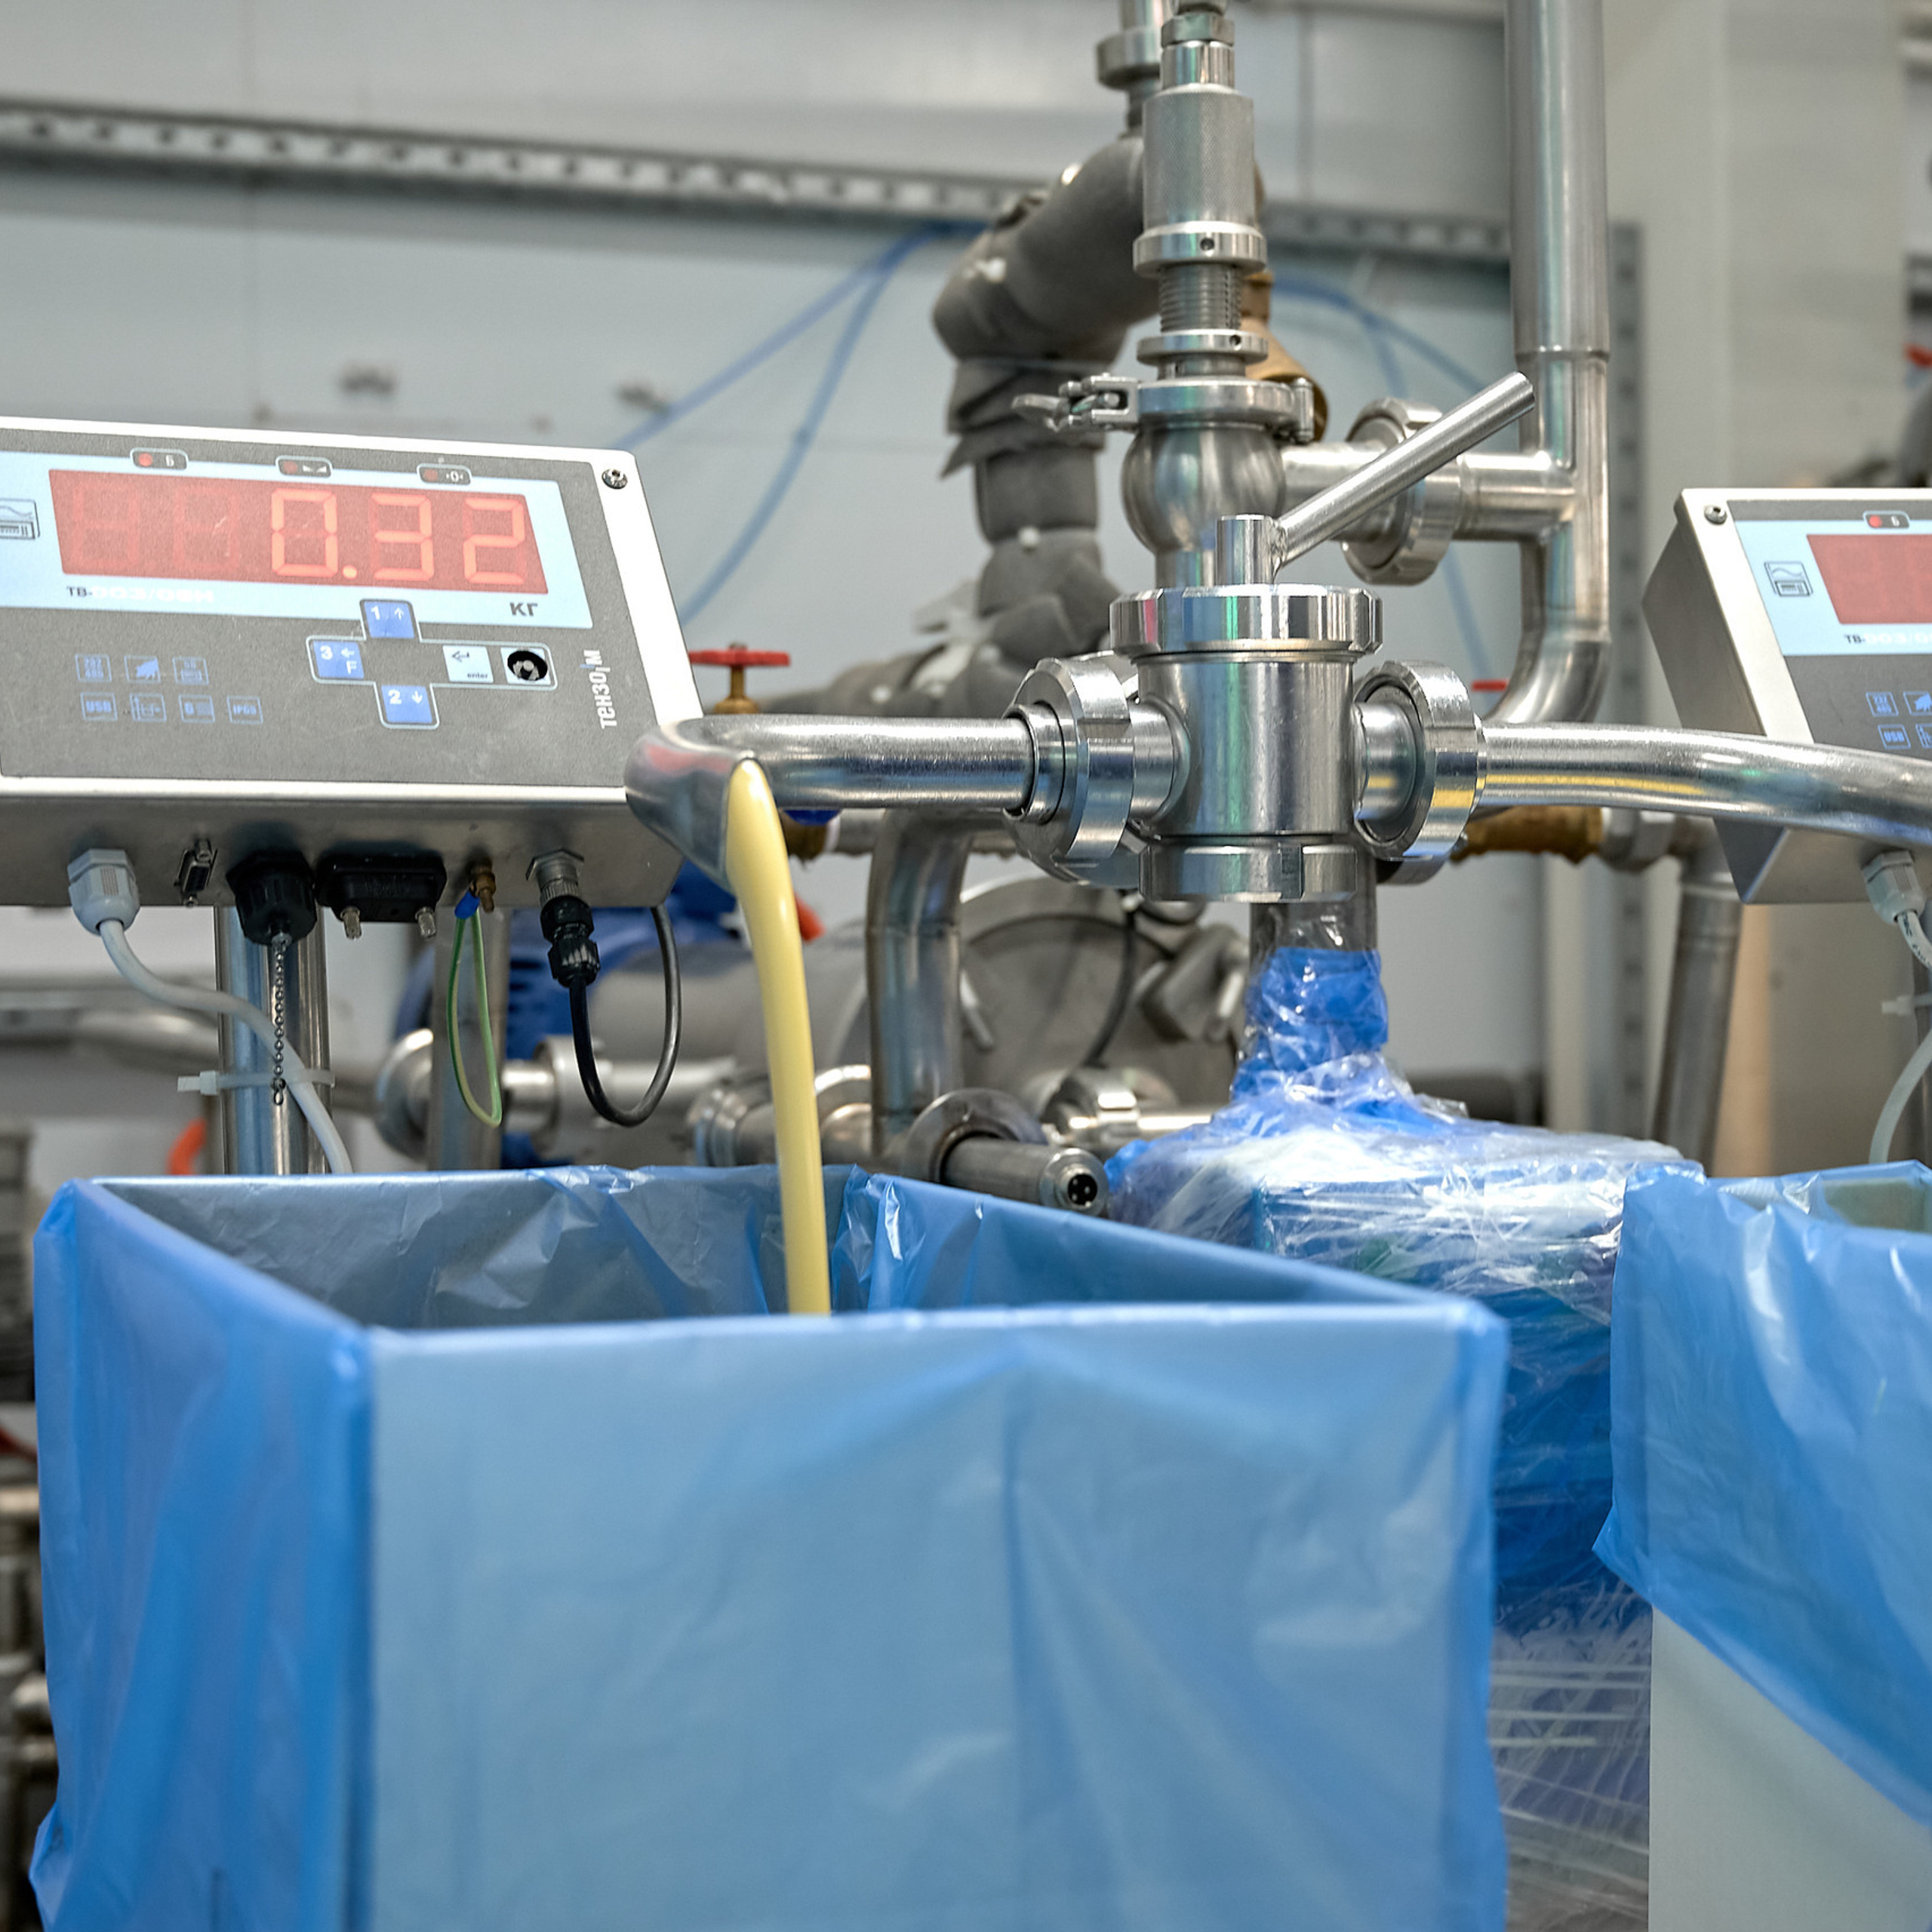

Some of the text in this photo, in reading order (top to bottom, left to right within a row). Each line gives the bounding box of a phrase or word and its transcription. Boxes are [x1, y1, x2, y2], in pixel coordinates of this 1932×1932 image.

[272, 488, 525, 585] 0.32
[371, 605, 381, 620] 1
[319, 645, 334, 660] 3
[346, 660, 357, 675] F
[388, 688, 402, 704] 2
[85, 700, 112, 713] USB
